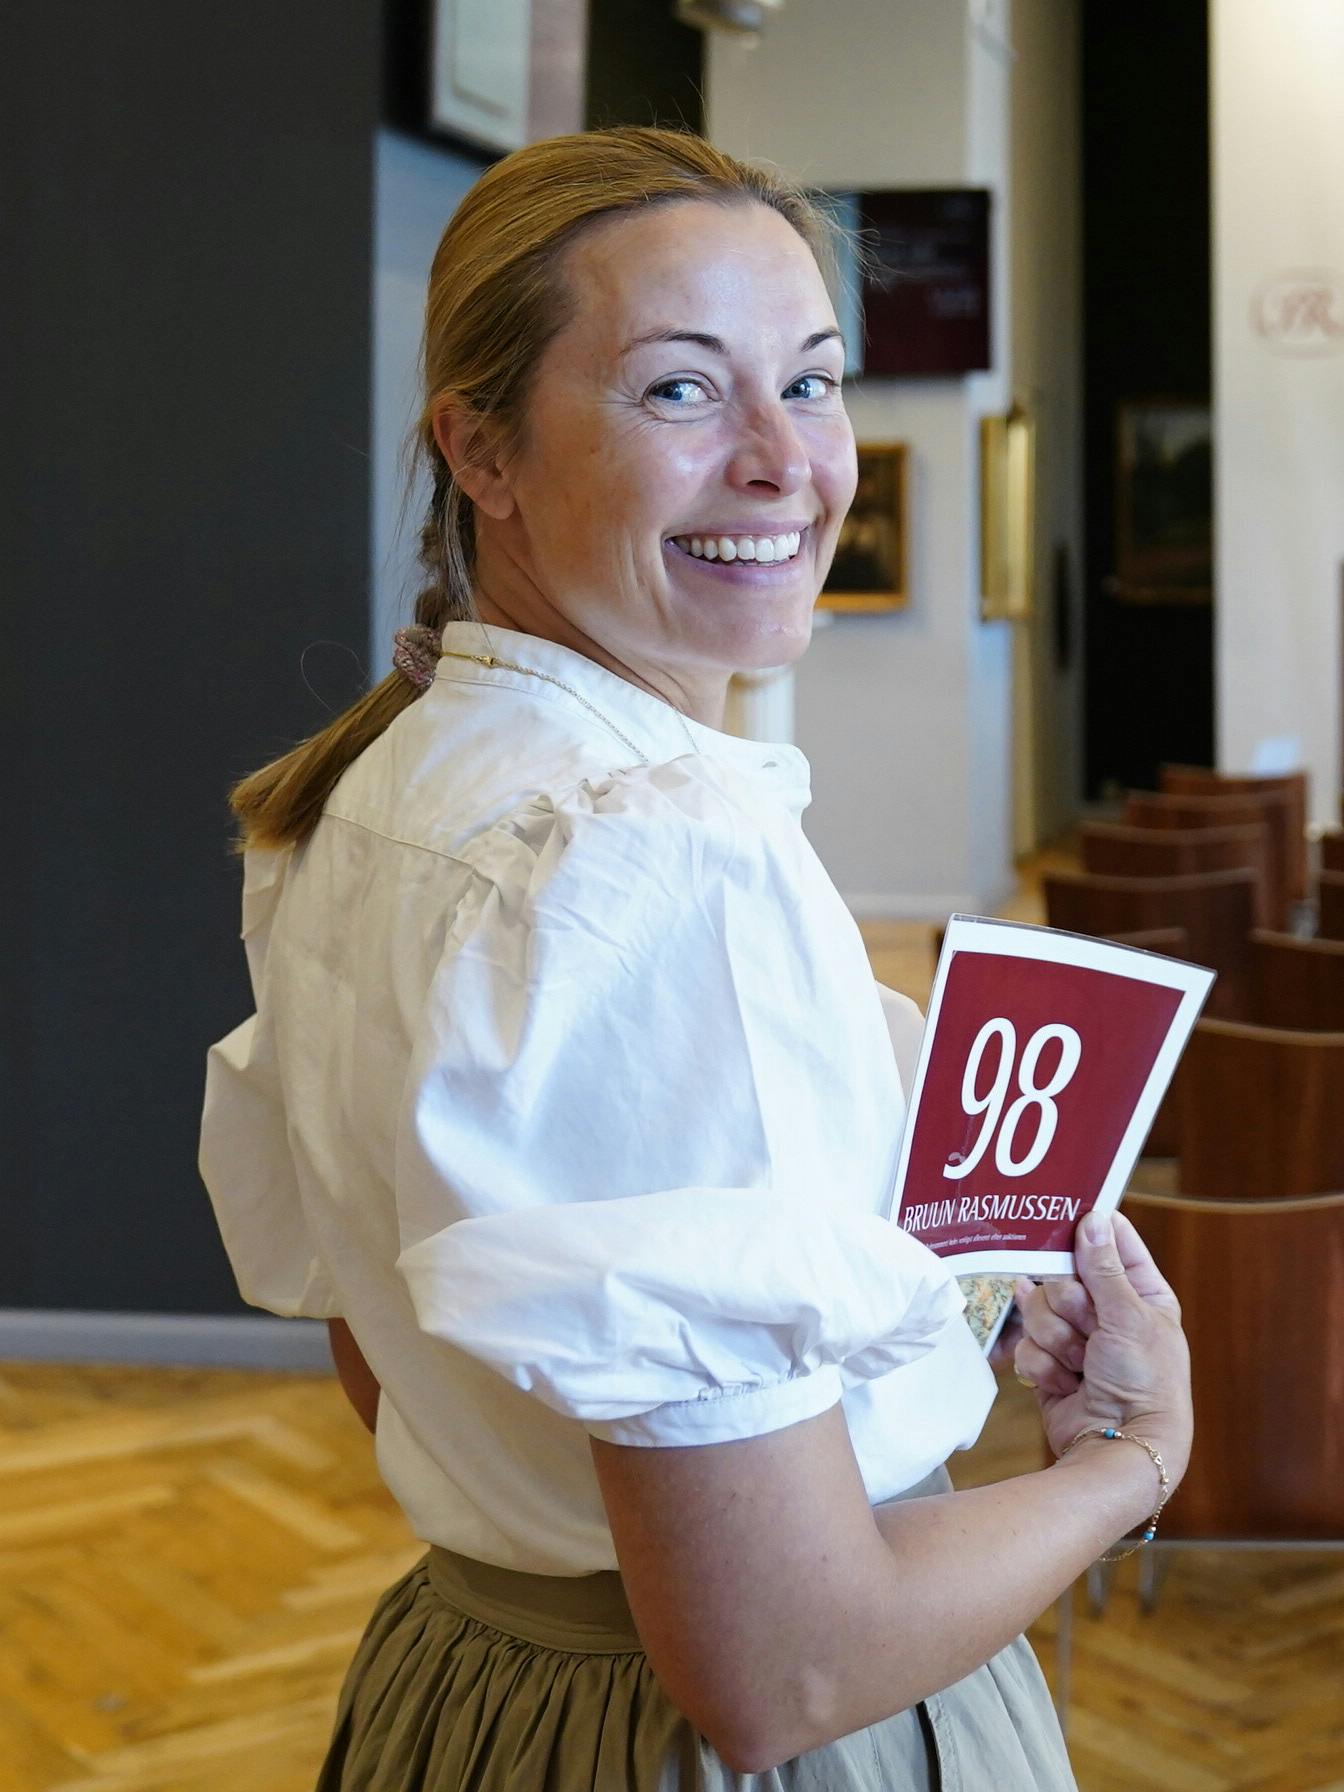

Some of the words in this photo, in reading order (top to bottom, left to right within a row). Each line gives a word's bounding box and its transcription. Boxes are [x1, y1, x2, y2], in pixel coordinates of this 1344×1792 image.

[943, 1017, 1082, 1180] 98
[903, 1199, 956, 1233] BRUUN
[957, 1194, 1081, 1223] RASMUSSEN
